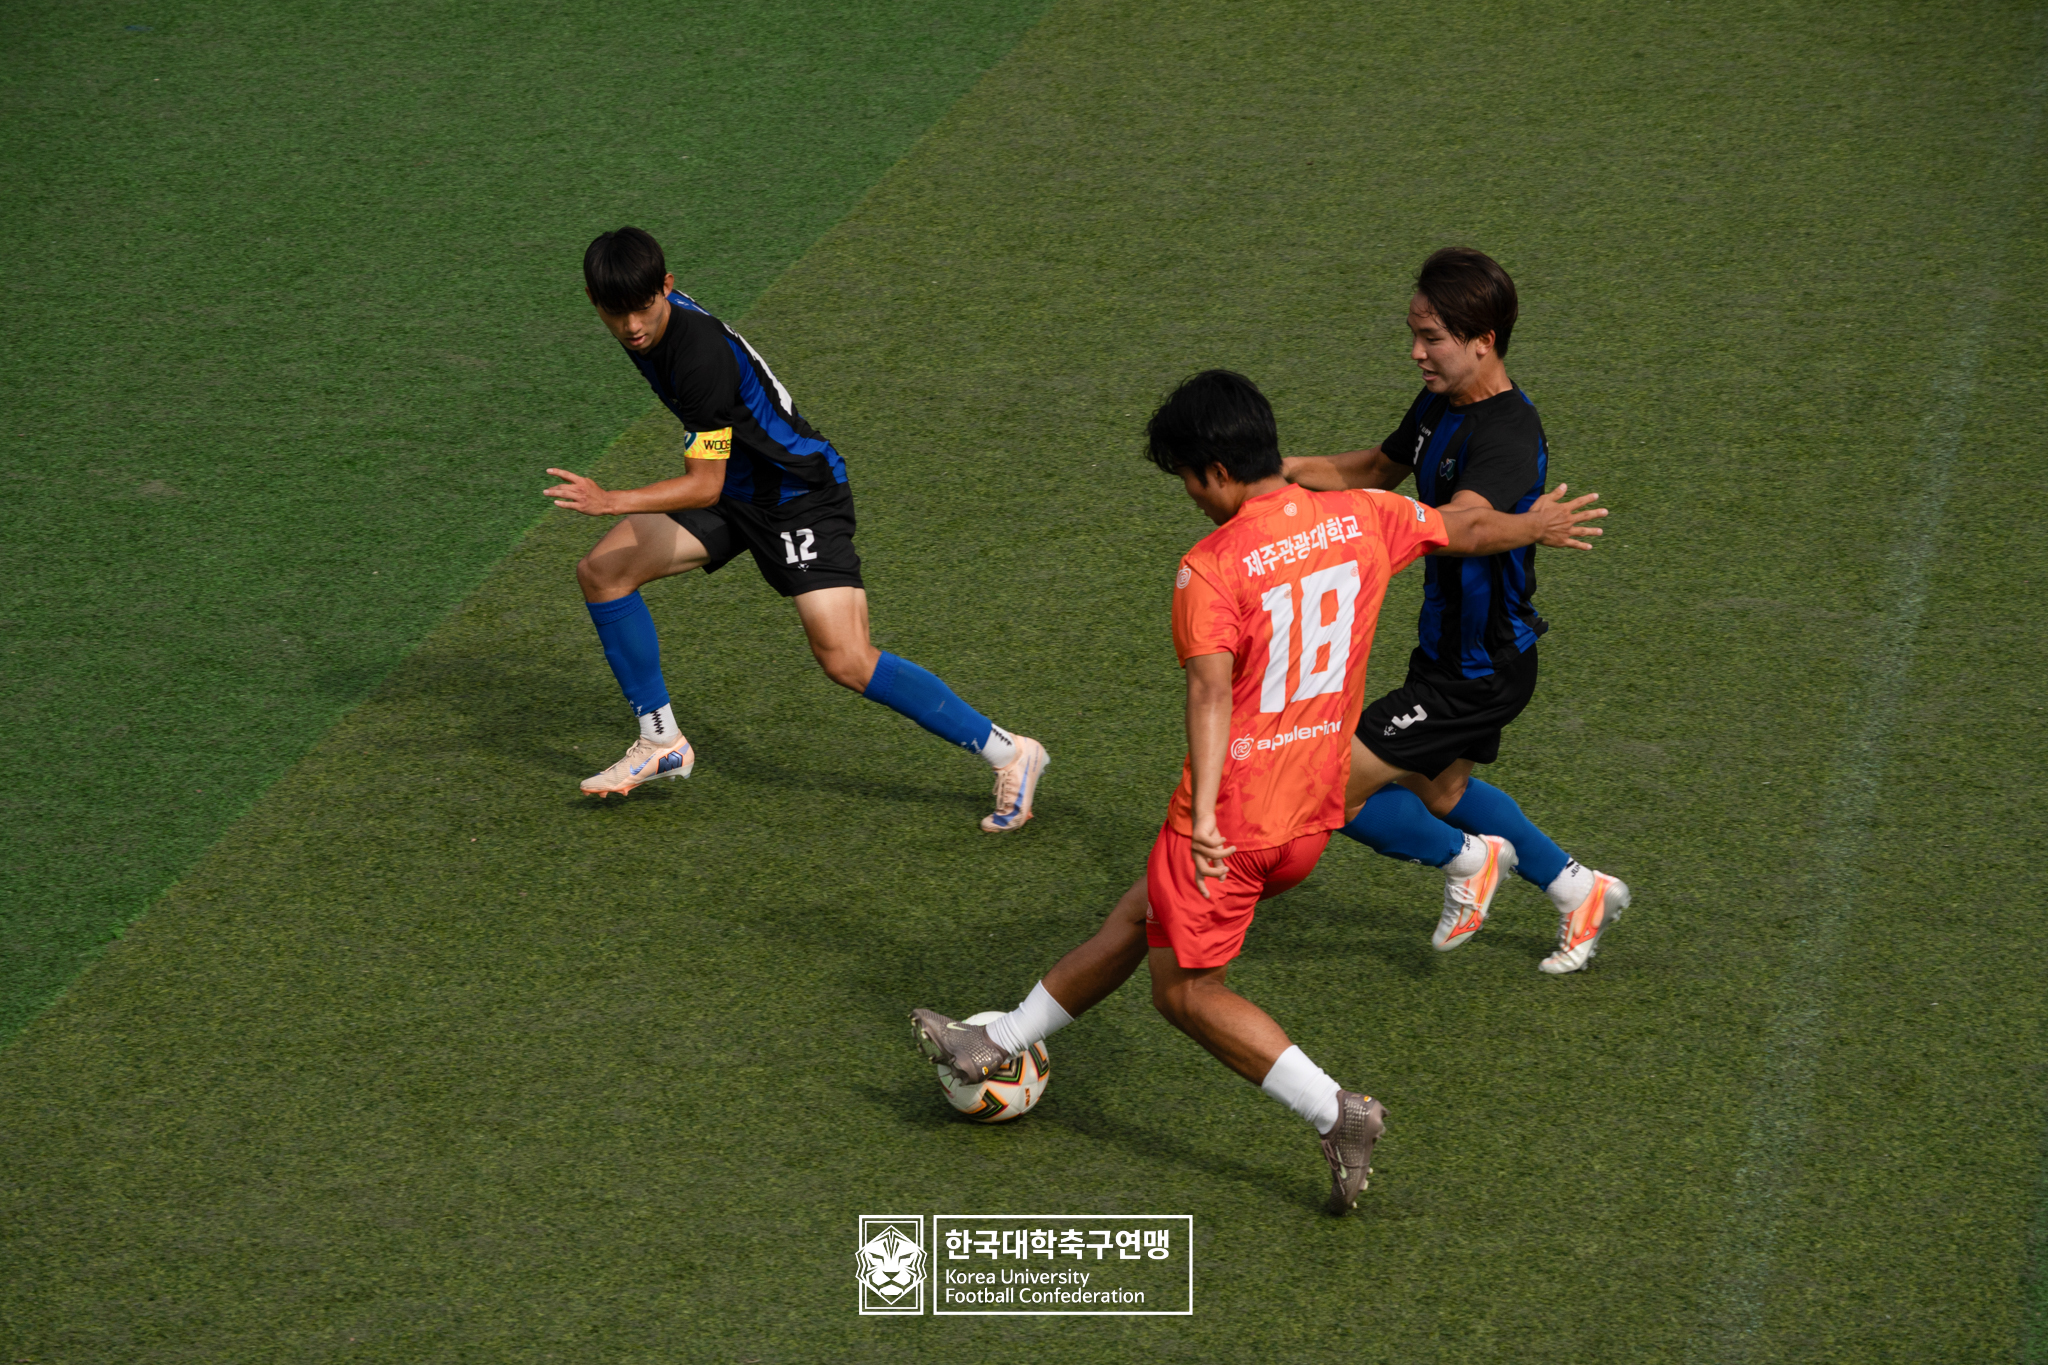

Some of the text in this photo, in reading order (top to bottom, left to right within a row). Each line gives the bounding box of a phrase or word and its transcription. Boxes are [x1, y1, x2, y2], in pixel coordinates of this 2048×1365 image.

[780, 528, 818, 565] 12
[1242, 515, 1363, 578] 제주관광대학교
[1259, 559, 1362, 714] 18
[1391, 704, 1428, 730] 3
